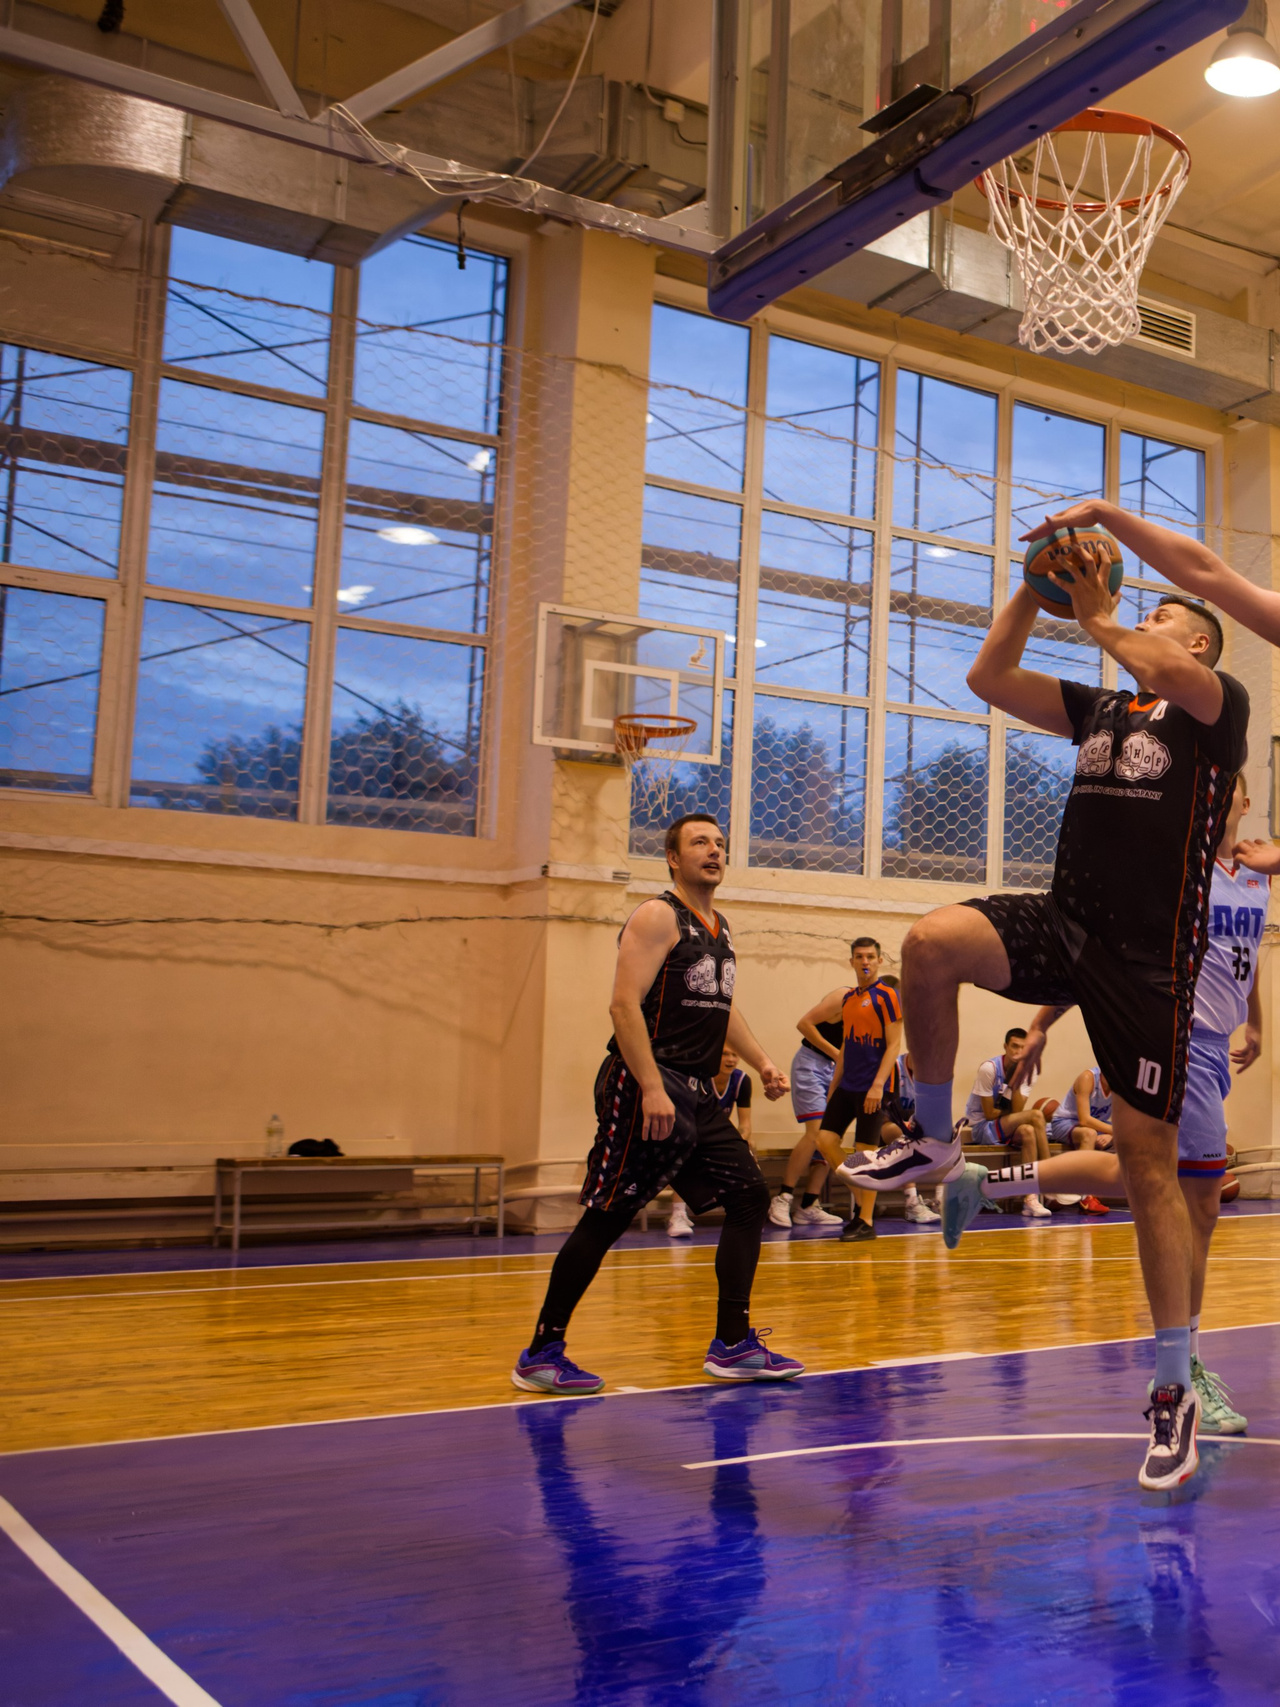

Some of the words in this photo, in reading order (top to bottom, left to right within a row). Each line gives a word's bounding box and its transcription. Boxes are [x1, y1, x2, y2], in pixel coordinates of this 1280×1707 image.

[1125, 788, 1163, 800] COMPANY
[1213, 905, 1264, 938] ПАТ
[1136, 1057, 1161, 1095] 10
